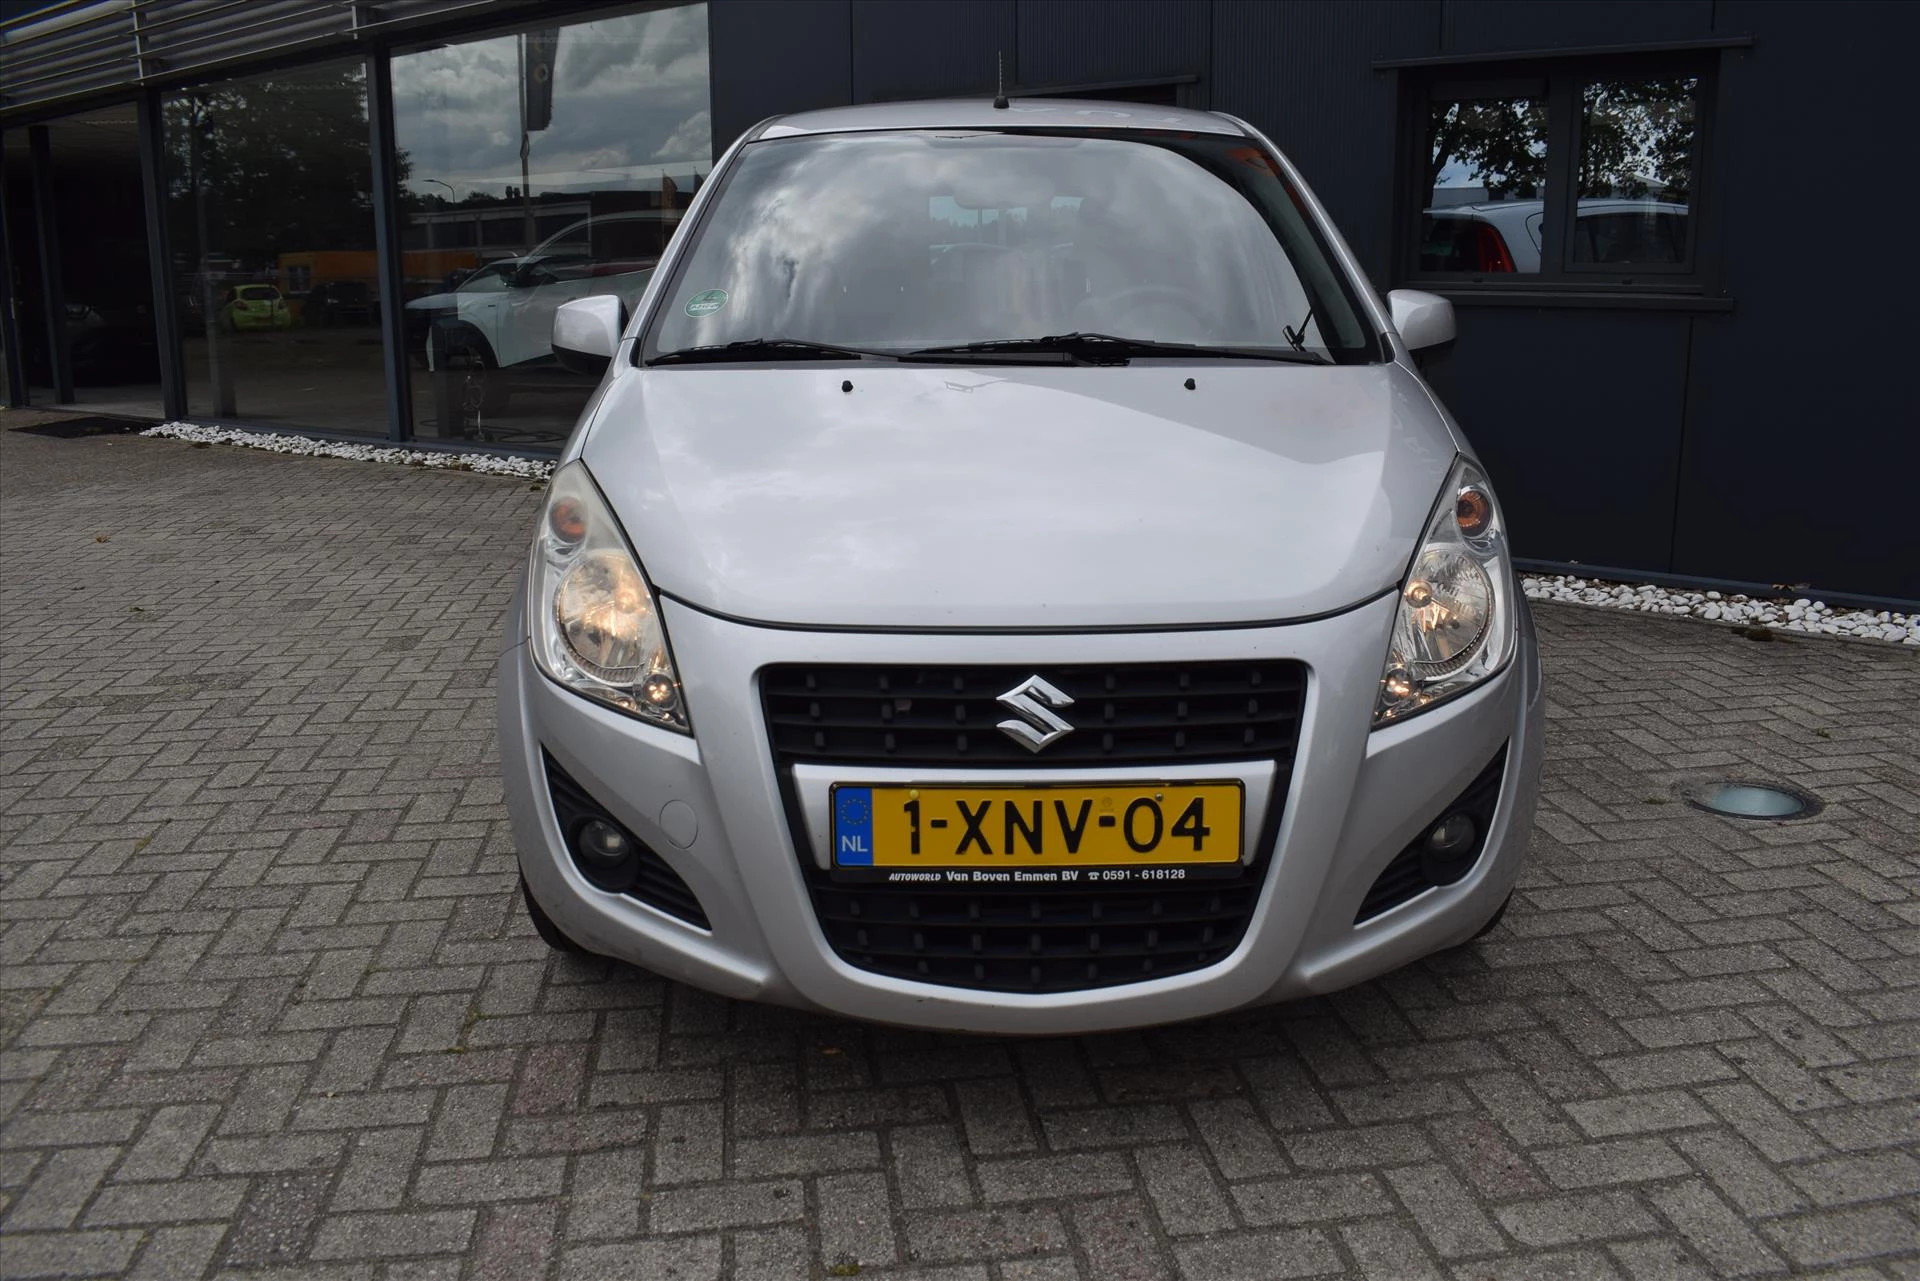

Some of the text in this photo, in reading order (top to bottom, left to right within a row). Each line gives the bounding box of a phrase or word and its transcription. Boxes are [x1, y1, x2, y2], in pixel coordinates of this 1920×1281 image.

[903, 796, 1211, 855] 1-XNV-04
[841, 835, 868, 852] NL
[888, 872, 942, 881] AUTOWORLD
[945, 871, 969, 881] Van
[973, 871, 1010, 881] Boven
[1014, 871, 1058, 881] Emmen
[1061, 870, 1079, 881] BV
[1102, 870, 1131, 880] 0591
[1141, 869, 1186, 880] 618128
